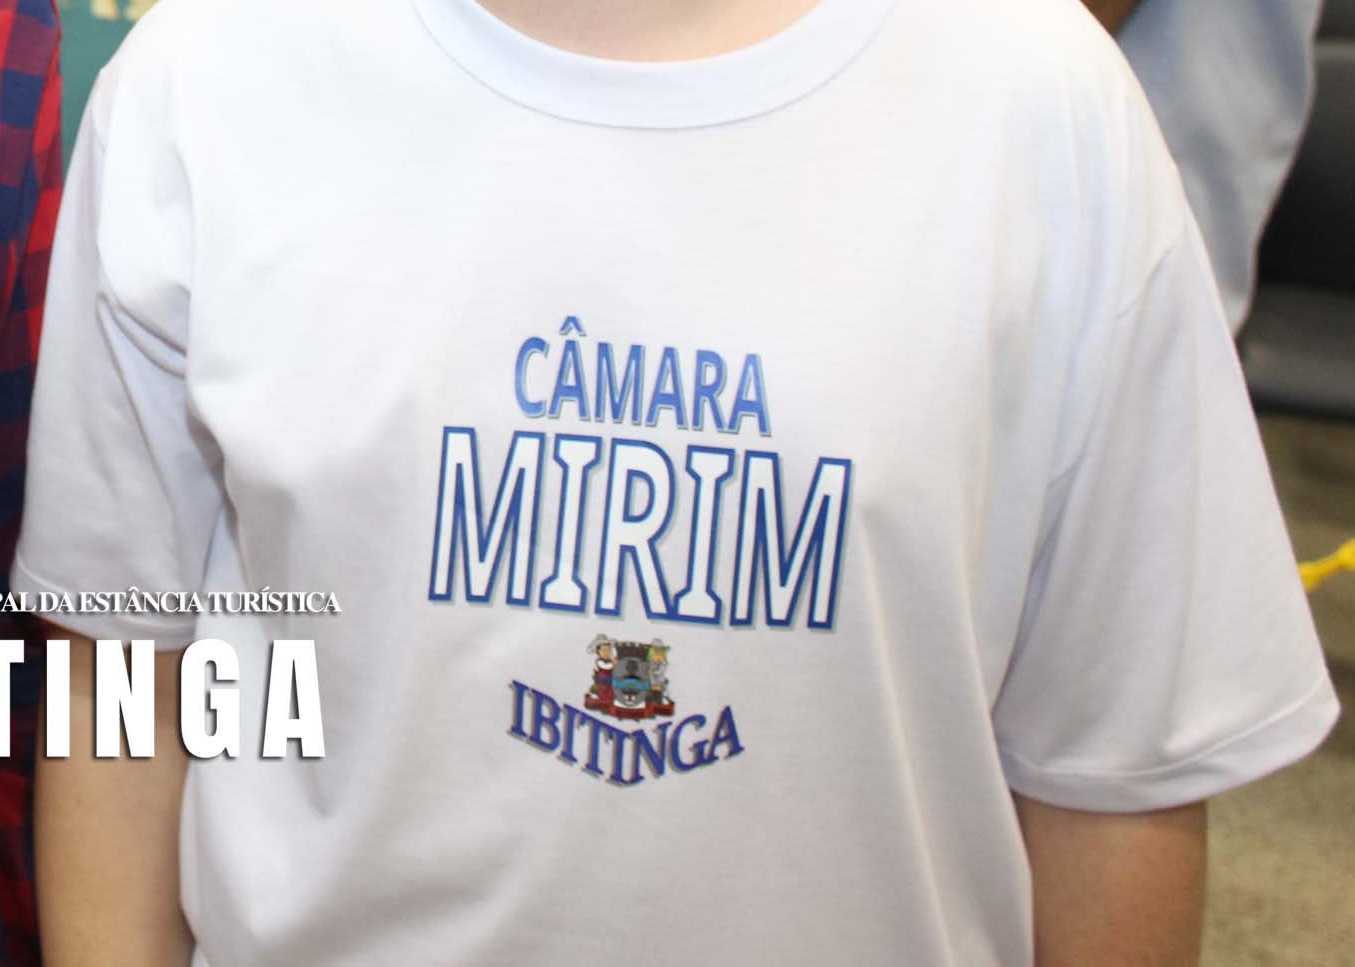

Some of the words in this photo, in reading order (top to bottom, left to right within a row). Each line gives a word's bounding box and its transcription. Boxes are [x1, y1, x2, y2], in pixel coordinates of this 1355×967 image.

[513, 315, 772, 436] CÂMARA
[428, 425, 853, 631] MIRIM
[506, 679, 745, 787] IBITINGA
